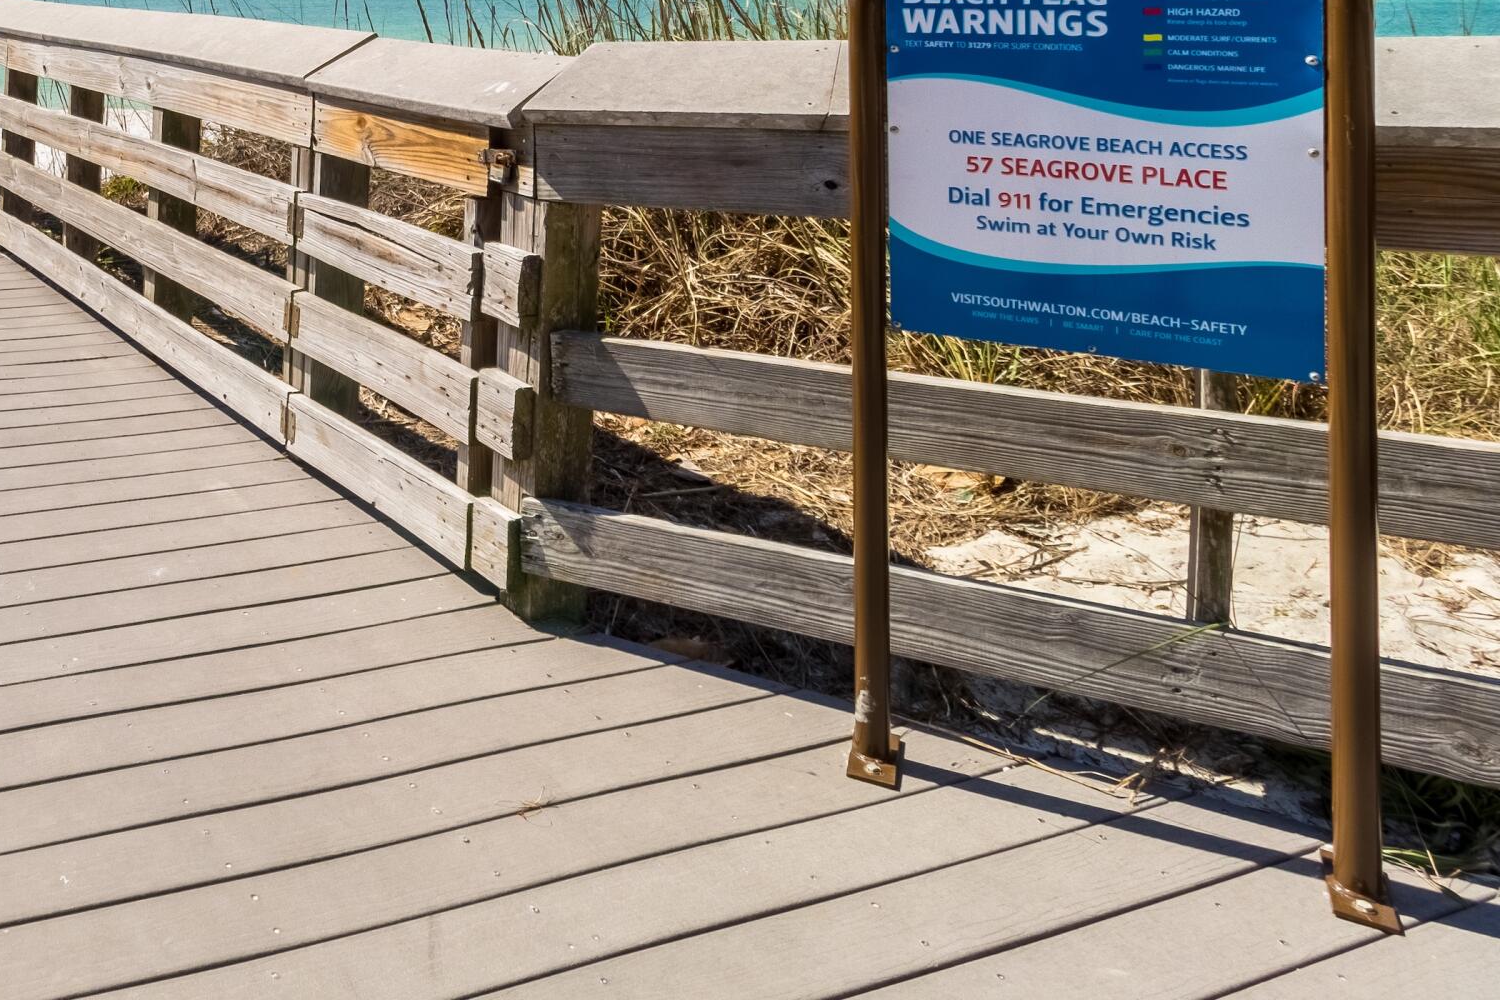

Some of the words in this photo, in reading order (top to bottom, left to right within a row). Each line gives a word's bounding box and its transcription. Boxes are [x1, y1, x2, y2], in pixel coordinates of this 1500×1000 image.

[903, 9, 1109, 37] WARNINGS
[1167, 8, 1193, 16] HIGH
[1196, 9, 1240, 17] HAZARD
[905, 40, 922, 48] TEXT
[924, 40, 953, 48] SAFETY
[1011, 42, 1031, 50] SURF
[1033, 43, 1083, 51] CONDITIONS
[1167, 64, 1215, 72] DANGEROUS
[949, 130, 986, 146] ONE
[991, 132, 1090, 152] SEAGROVE
[1096, 138, 1162, 156] BEACH
[1169, 141, 1248, 161] ACCESS
[966, 156, 993, 173] 57
[1001, 157, 1133, 184] SEAGROVE
[1142, 166, 1228, 190] PLACE
[948, 186, 991, 207] Dial
[998, 191, 1031, 210] 911
[1039, 192, 1073, 213] for
[1081, 197, 1250, 228] Emergencies
[976, 215, 1030, 234] Swim
[1037, 222, 1056, 236] at
[1064, 222, 1109, 241] Your
[1116, 227, 1164, 246] Own
[1171, 232, 1216, 251] Risk
[951, 292, 1247, 336] VISITSOUTHWALTON.COM/BEACH-SAFETY
[972, 310, 995, 320] KNOW
[997, 313, 1013, 322] THE
[1015, 315, 1039, 325] LAWS
[1063, 321, 1074, 329] BE
[1076, 322, 1104, 332] SMART
[1130, 328, 1152, 338] CARE
[1154, 331, 1172, 340] FOR
[1174, 334, 1191, 343] THE
[1193, 336, 1223, 346] COAST
